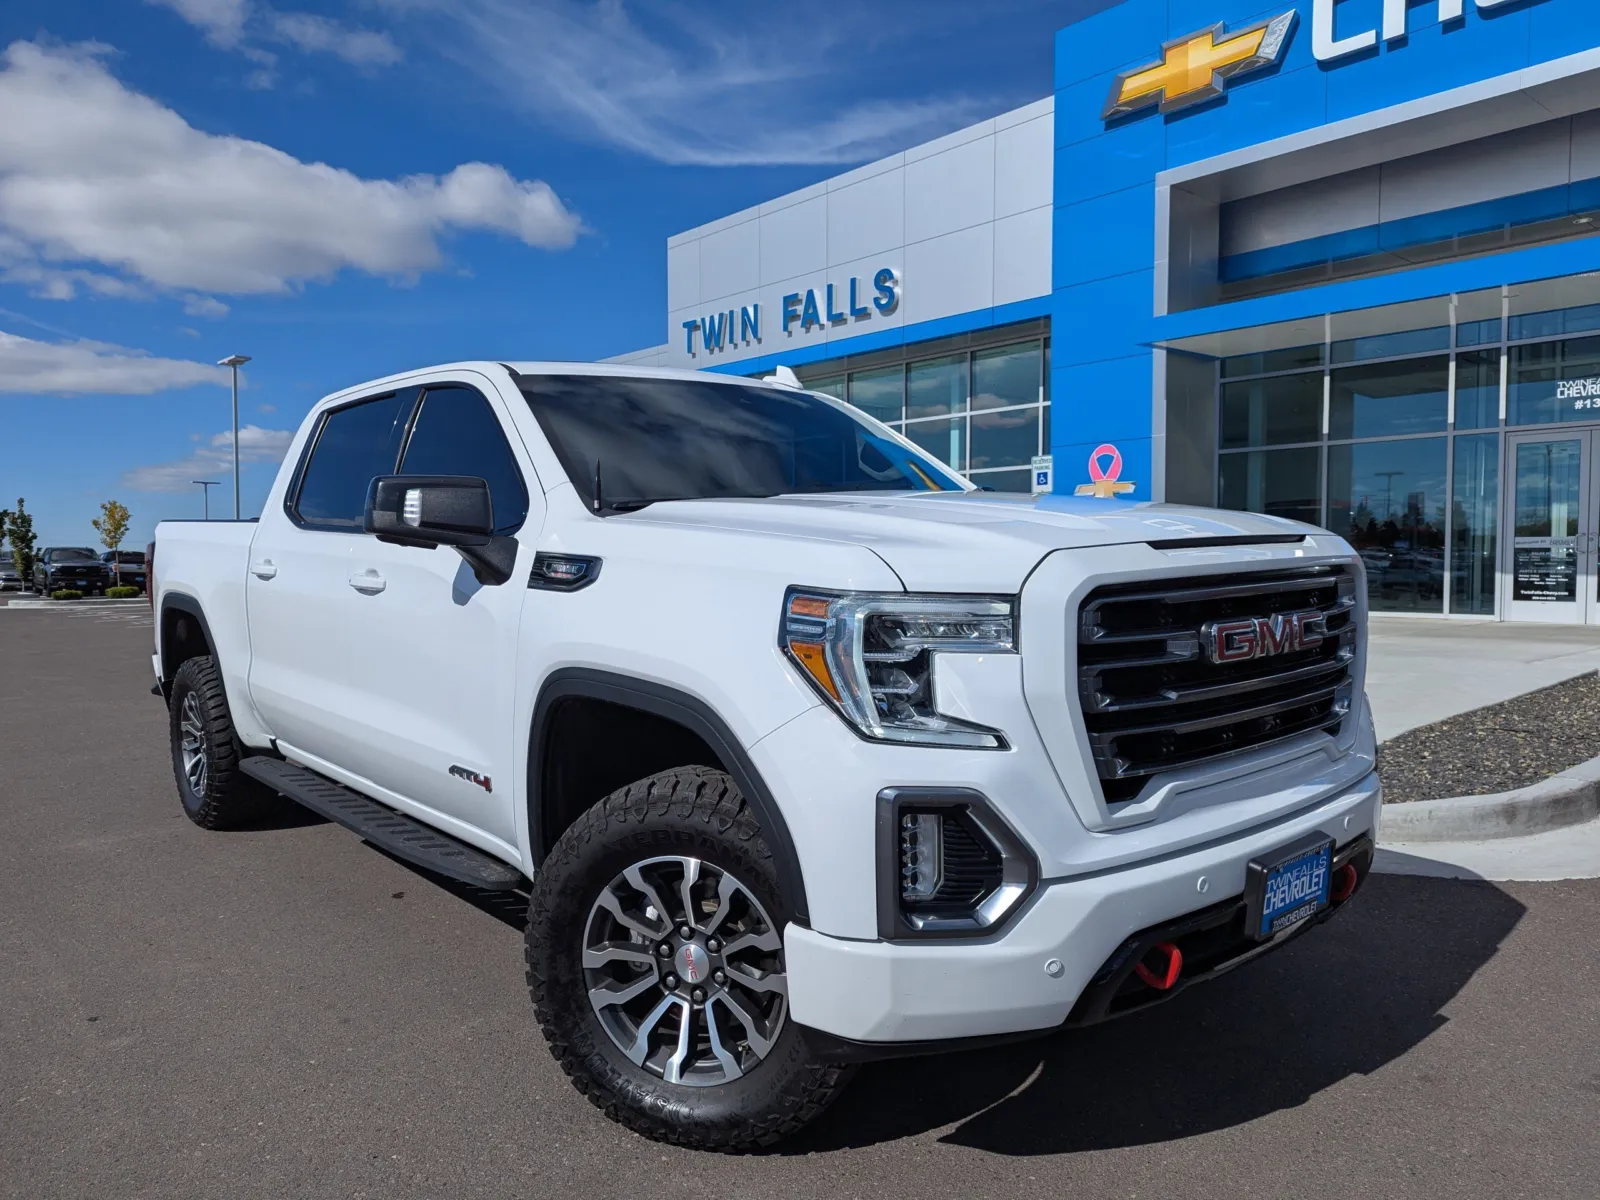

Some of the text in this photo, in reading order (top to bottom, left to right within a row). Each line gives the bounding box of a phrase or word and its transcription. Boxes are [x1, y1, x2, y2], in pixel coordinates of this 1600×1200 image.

[682, 268, 897, 354] TWIN FALLS
[1209, 611, 1324, 664] GMC
[1262, 867, 1326, 916] CHEVROLET
[1266, 856, 1327, 894] TWINFALLS
[684, 947, 699, 981] GMC
